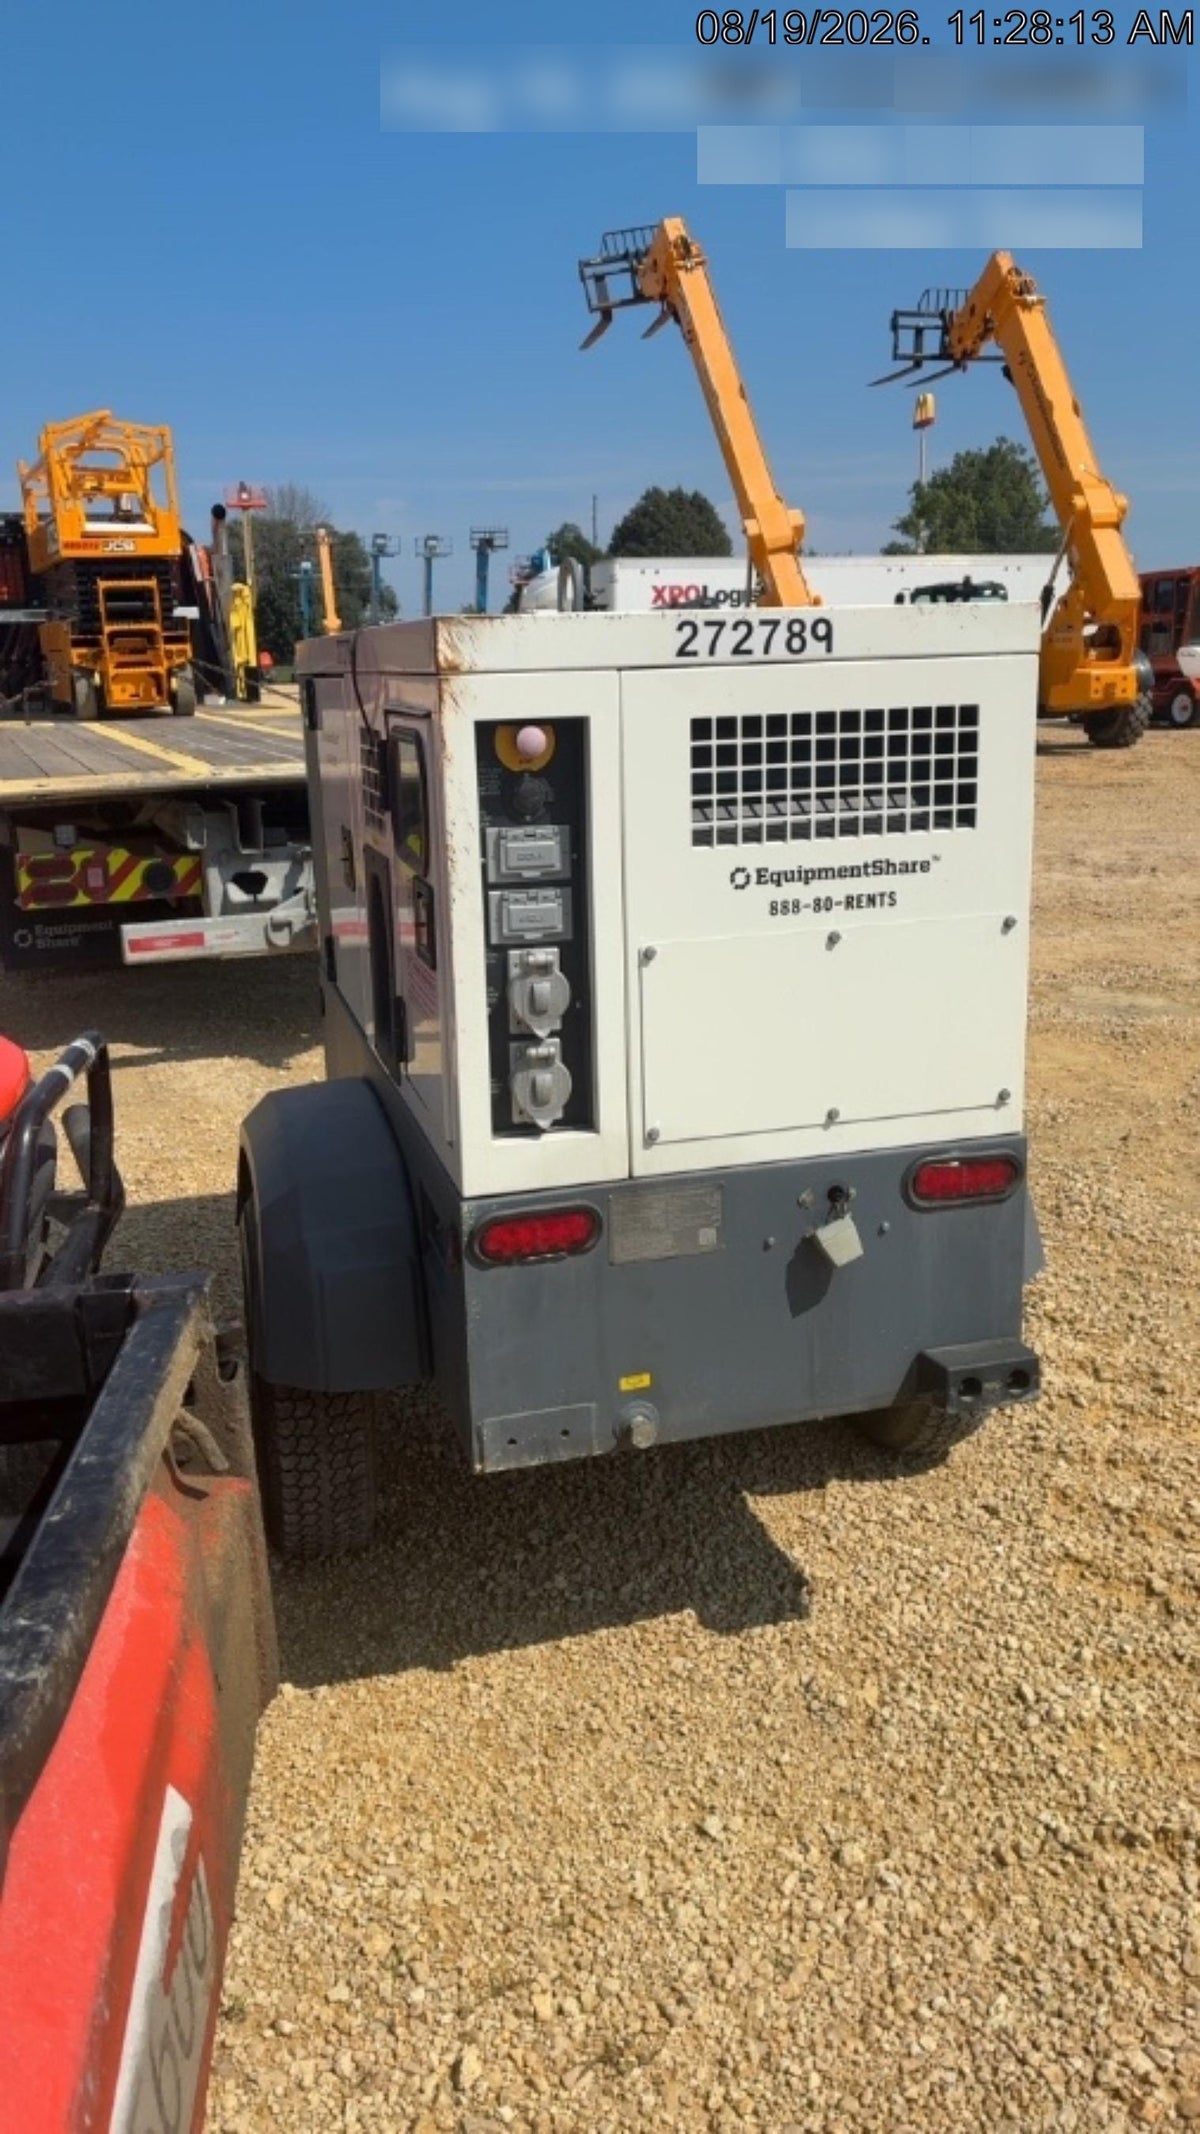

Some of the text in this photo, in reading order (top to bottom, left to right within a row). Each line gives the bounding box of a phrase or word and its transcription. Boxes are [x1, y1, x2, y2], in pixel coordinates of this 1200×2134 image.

[675, 617, 833, 658] 272789
[768, 891, 898, 916] 888-80-RENTS
[34, 921, 113, 937] Equipment
